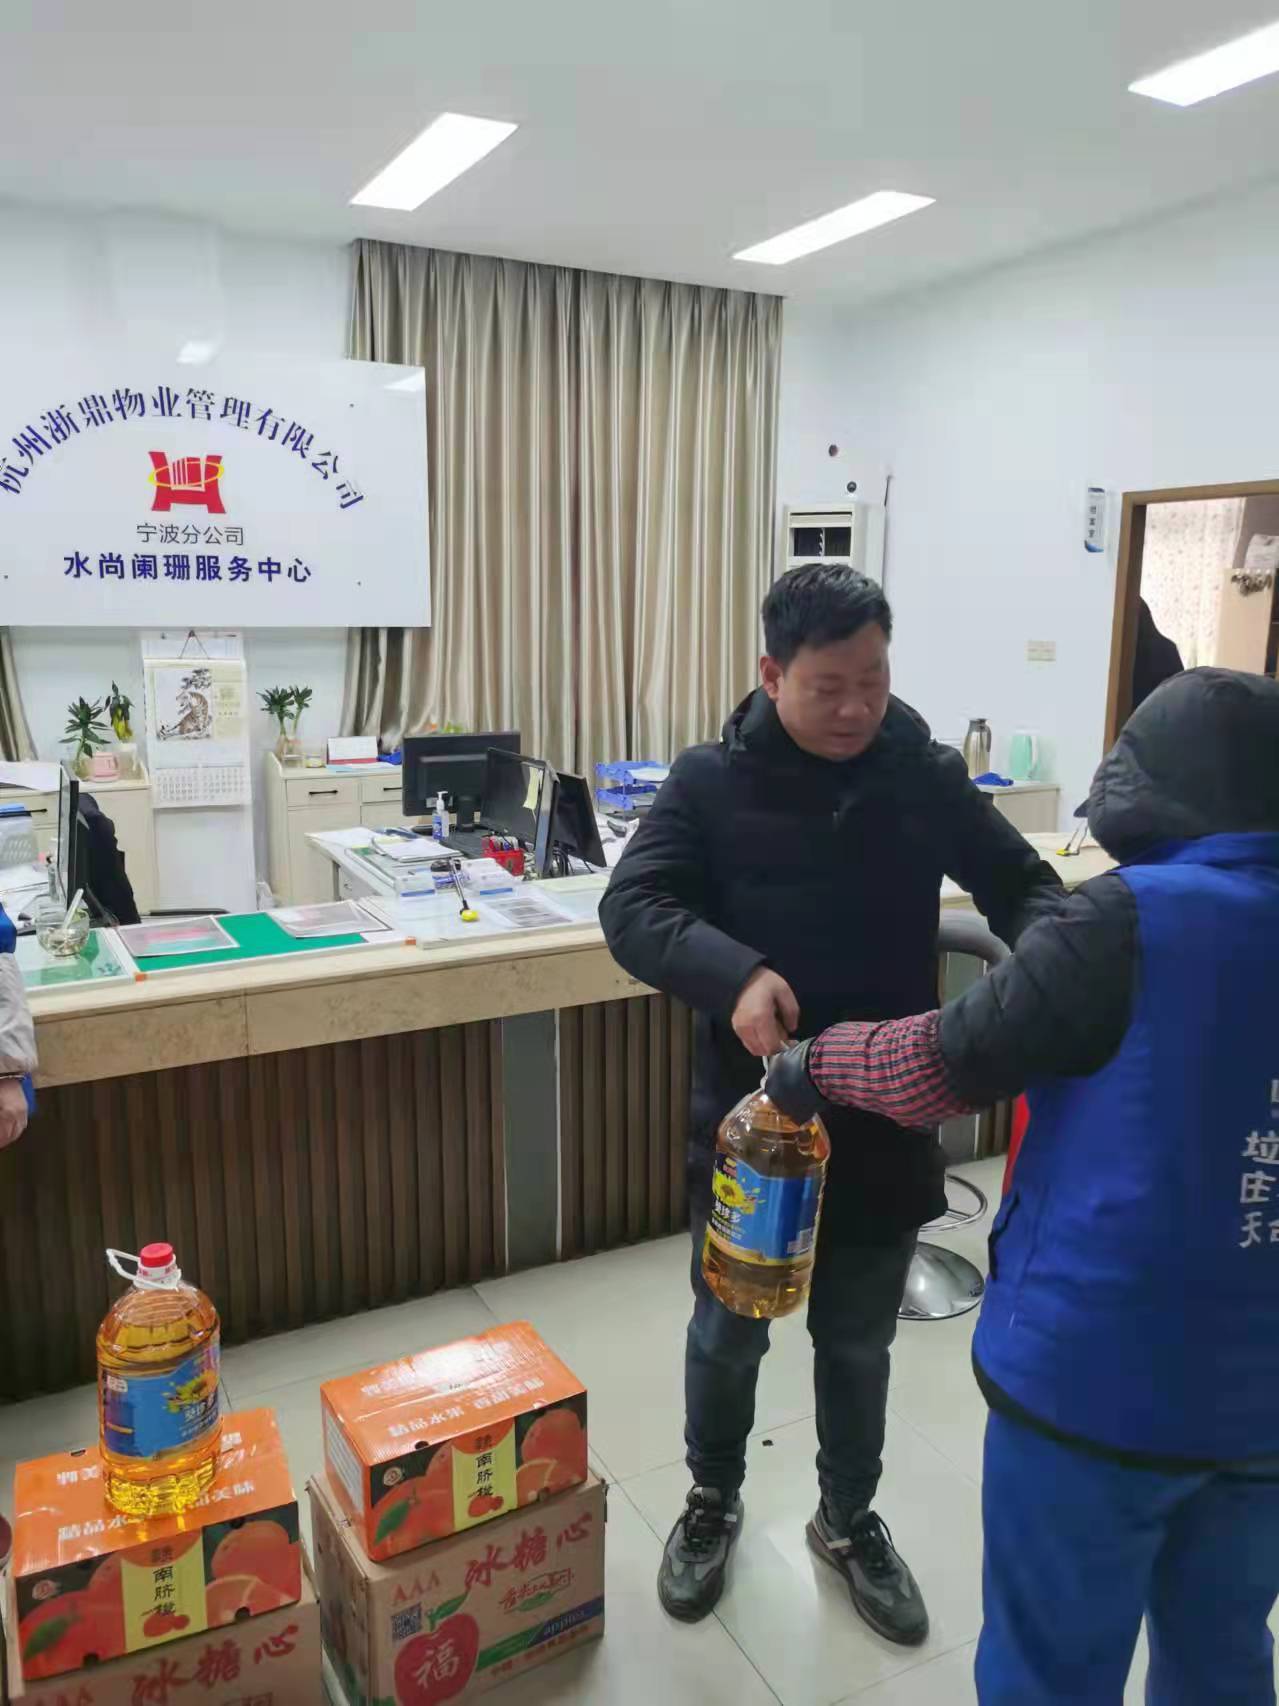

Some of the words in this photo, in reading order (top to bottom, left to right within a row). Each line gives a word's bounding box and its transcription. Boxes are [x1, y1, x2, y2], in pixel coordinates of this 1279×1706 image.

[0, 385, 365, 510] 杭州浙鼎物业管理有限公司
[136, 523, 245, 546] 宁波分公司
[63, 552, 312, 584] 水尚阑珊服务中心
[464, 1512, 593, 1590] 冰糖心
[415, 1639, 460, 1691] 福
